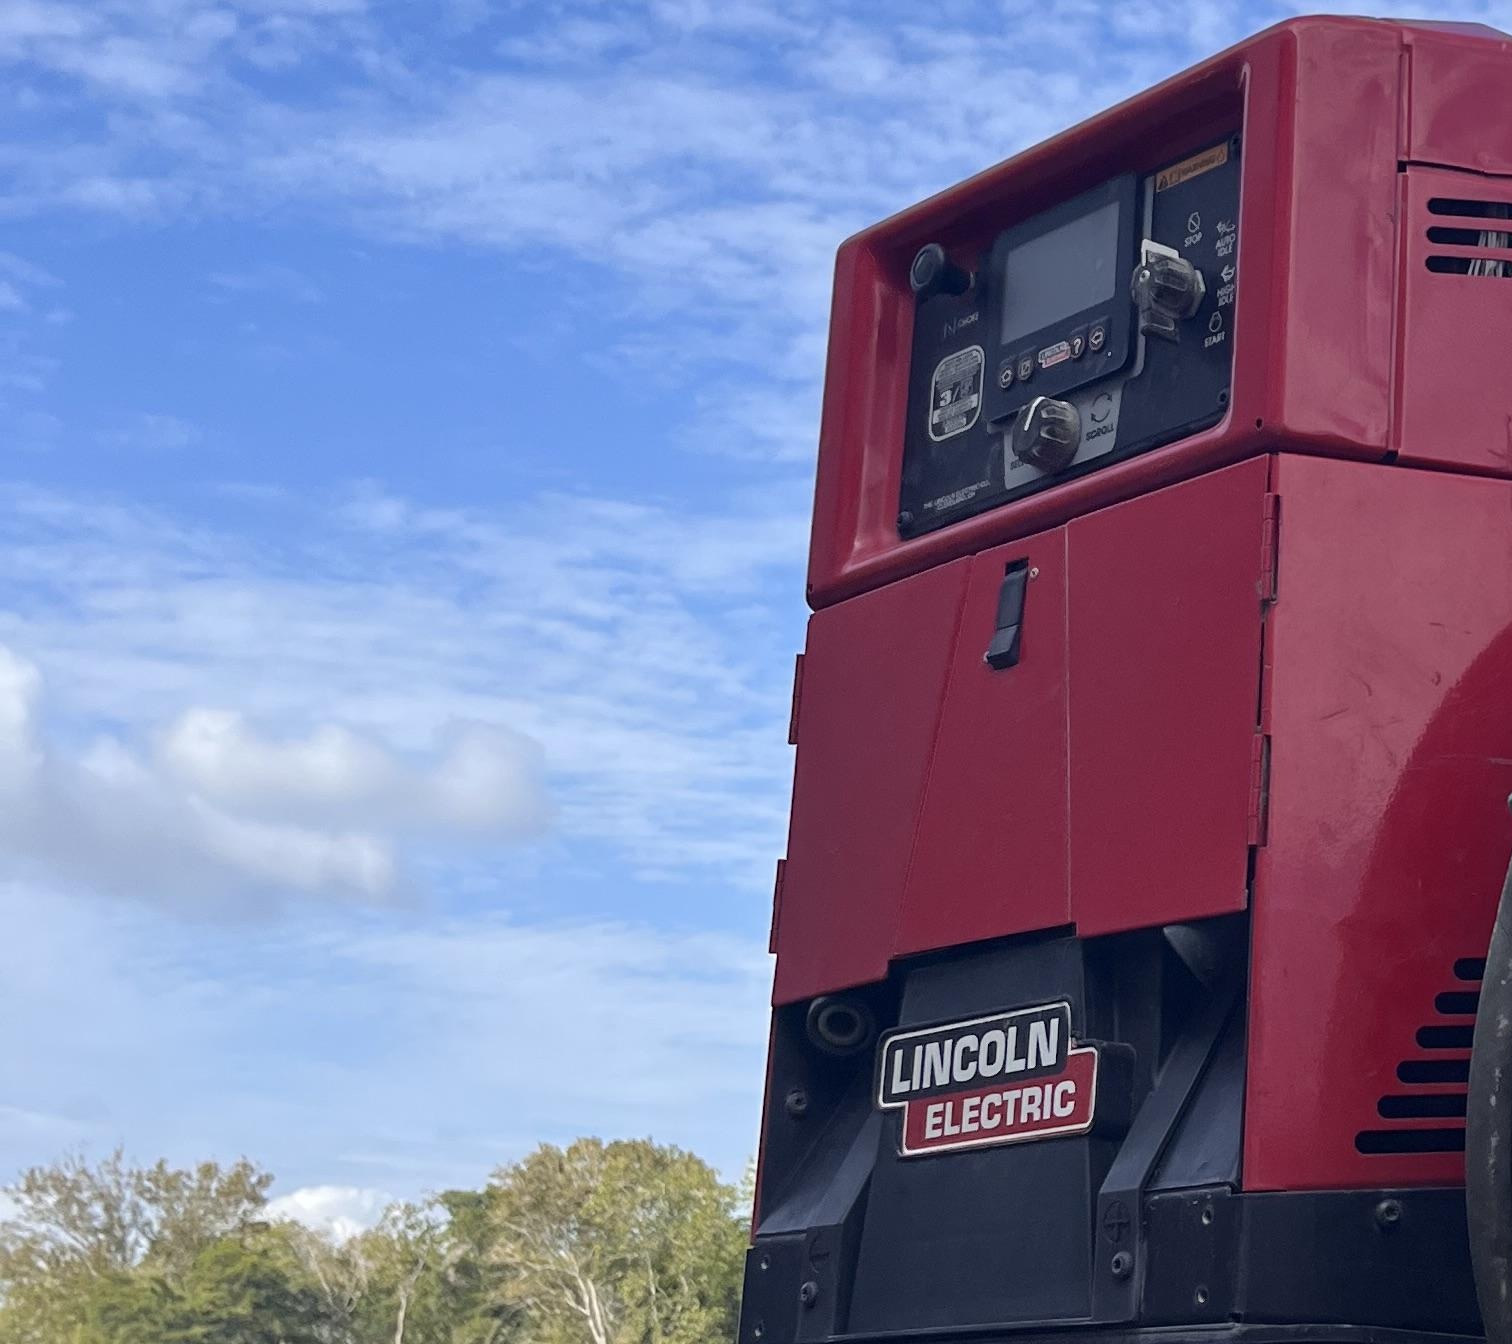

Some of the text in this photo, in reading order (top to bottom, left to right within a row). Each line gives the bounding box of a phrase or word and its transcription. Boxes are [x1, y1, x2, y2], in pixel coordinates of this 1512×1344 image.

[1085, 423, 1115, 442] SCROLL
[891, 1017, 1060, 1095] LINCOLN
[924, 1079, 1077, 1140] ELECTRIC
